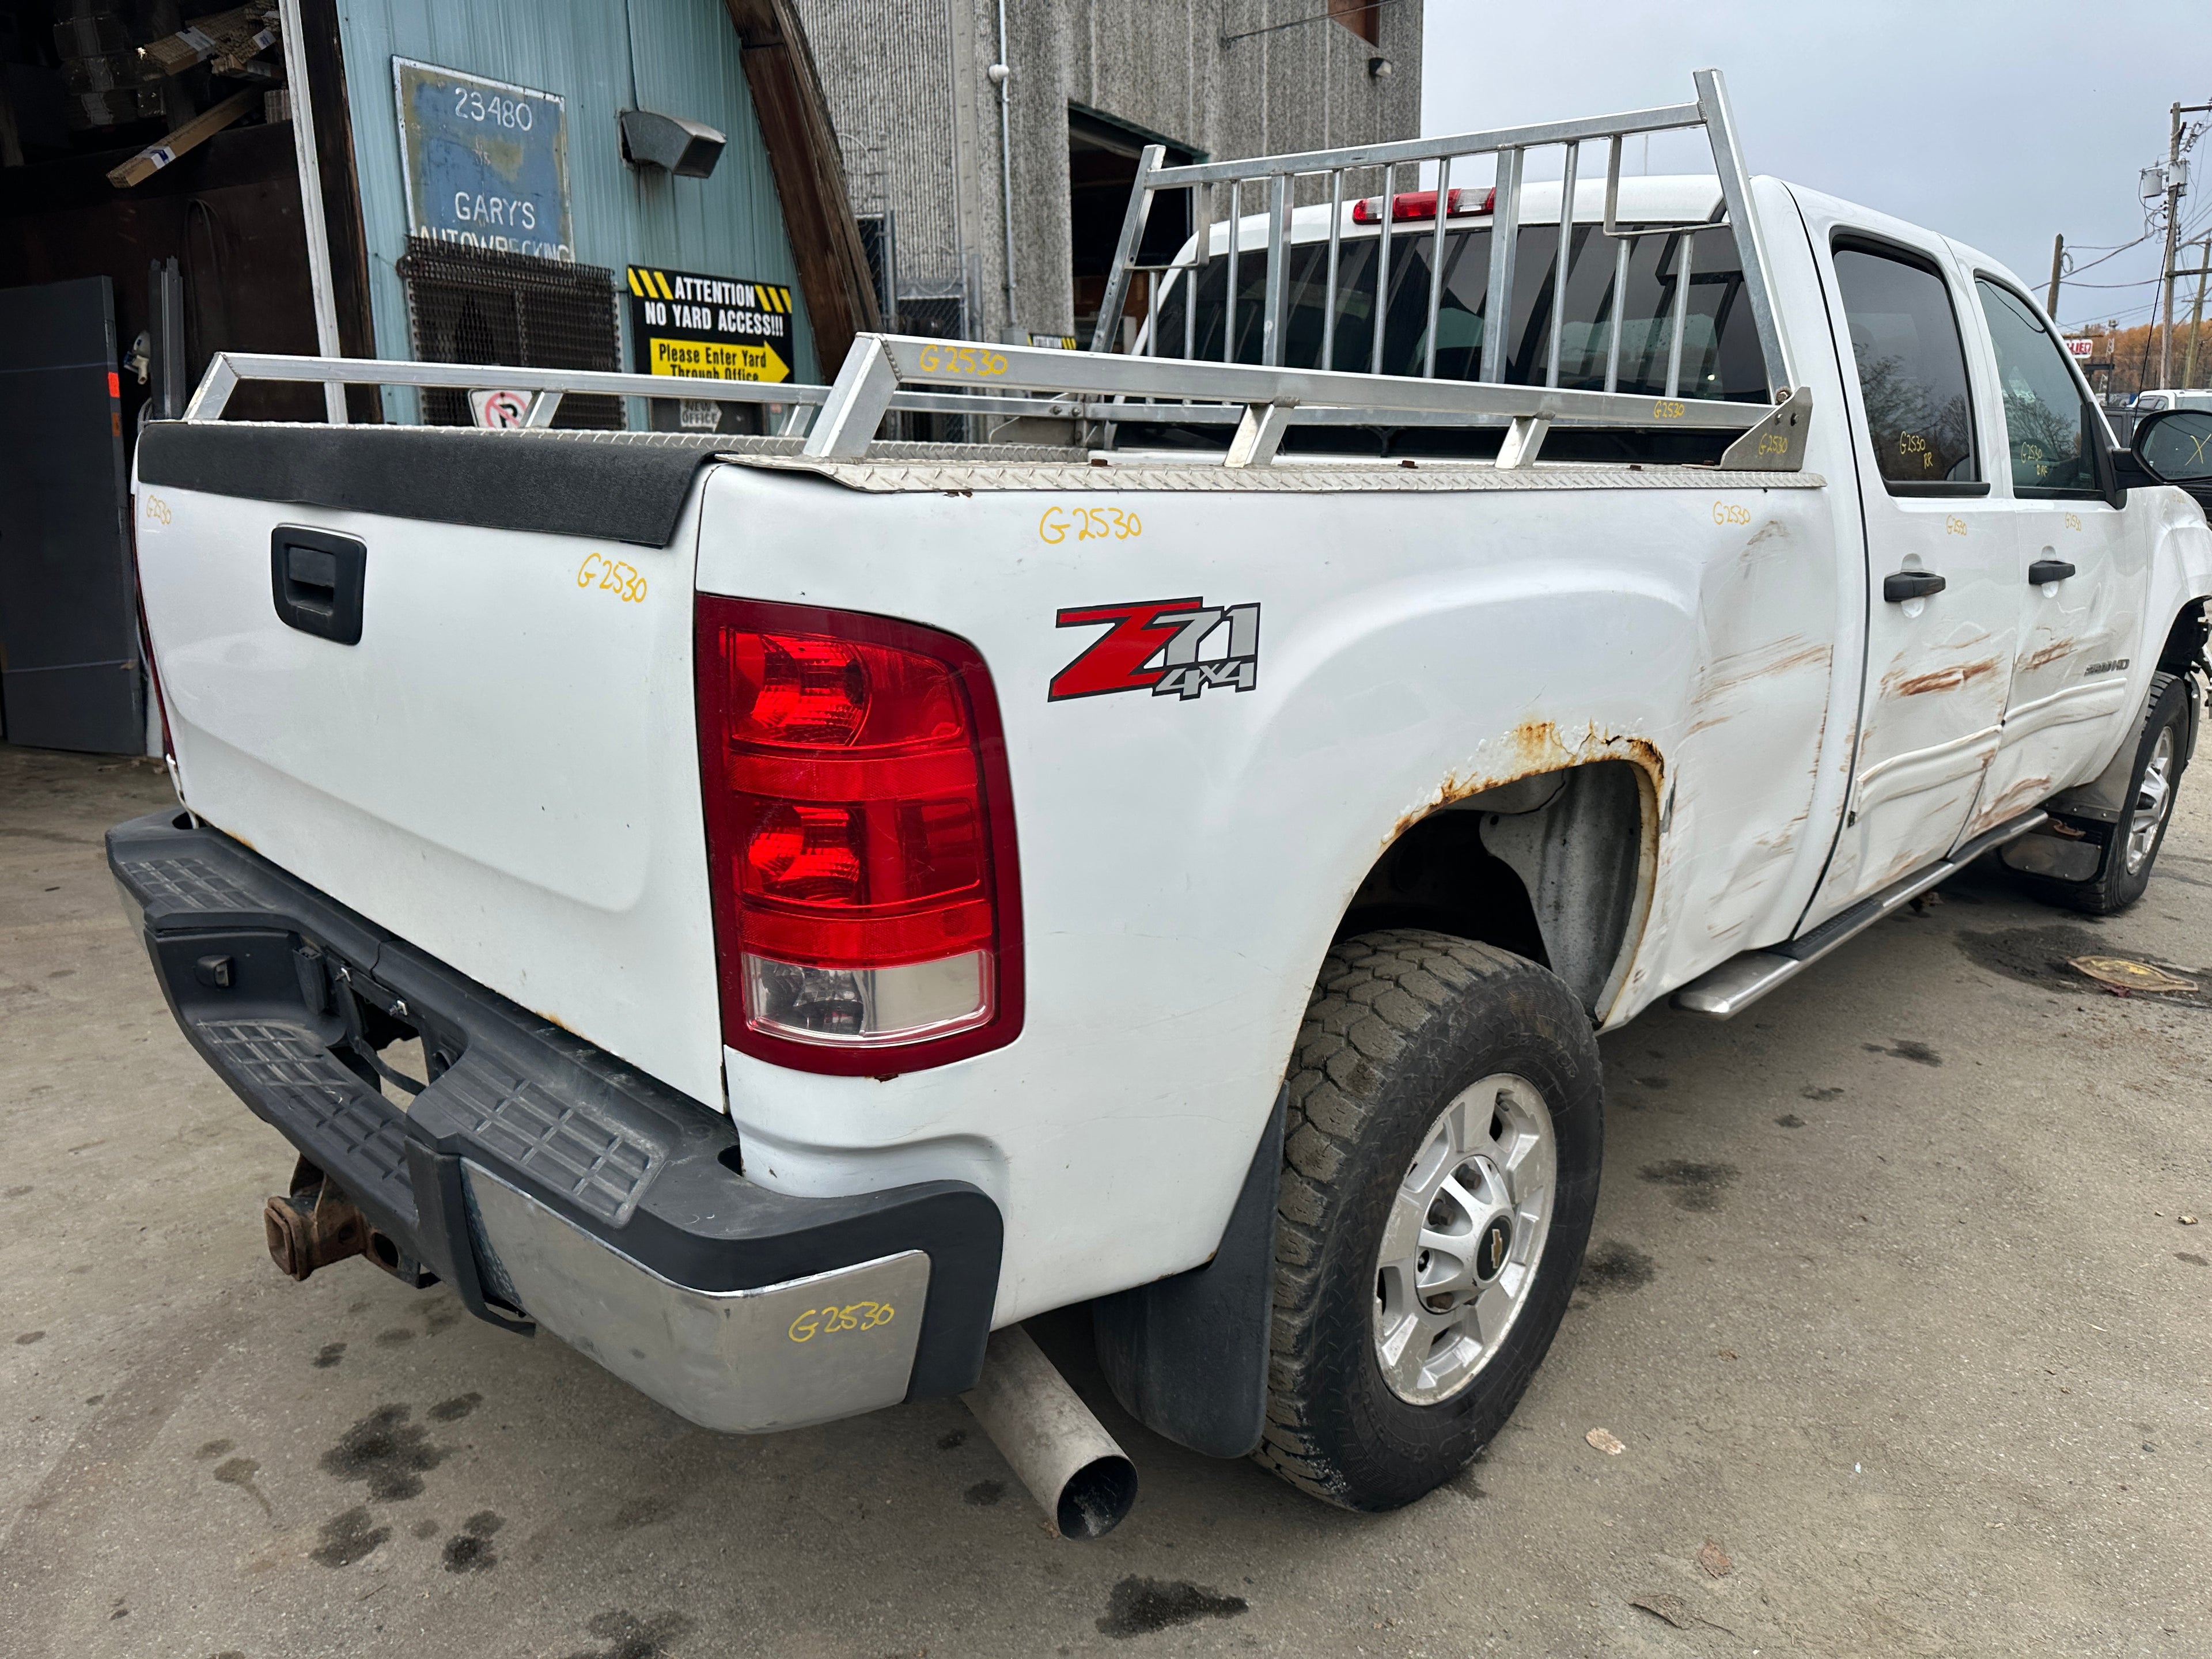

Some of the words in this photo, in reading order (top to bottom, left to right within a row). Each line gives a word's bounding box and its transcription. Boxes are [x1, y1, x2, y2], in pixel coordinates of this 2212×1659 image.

[455, 87, 532, 131] 23480
[455, 191, 535, 230] GARY'S
[675, 276, 755, 308] ATTENTION
[645, 301, 666, 325] NO
[672, 304, 712, 329] YARD
[718, 309, 784, 337] ACCESS!!!
[659, 343, 700, 363] Please
[706, 347, 737, 365] Enter
[742, 350, 766, 368] Yard
[919, 344, 1008, 377] G2530
[1654, 400, 1685, 419] G2530
[1758, 433, 1788, 456] G2530
[1900, 430, 1926, 455] G2530
[1039, 506, 1142, 544] G2530
[1713, 501, 1751, 525] G2530
[577, 552, 647, 603] G2530
[1048, 596, 1260, 702] Z71
[789, 1301, 895, 1343] G2530
